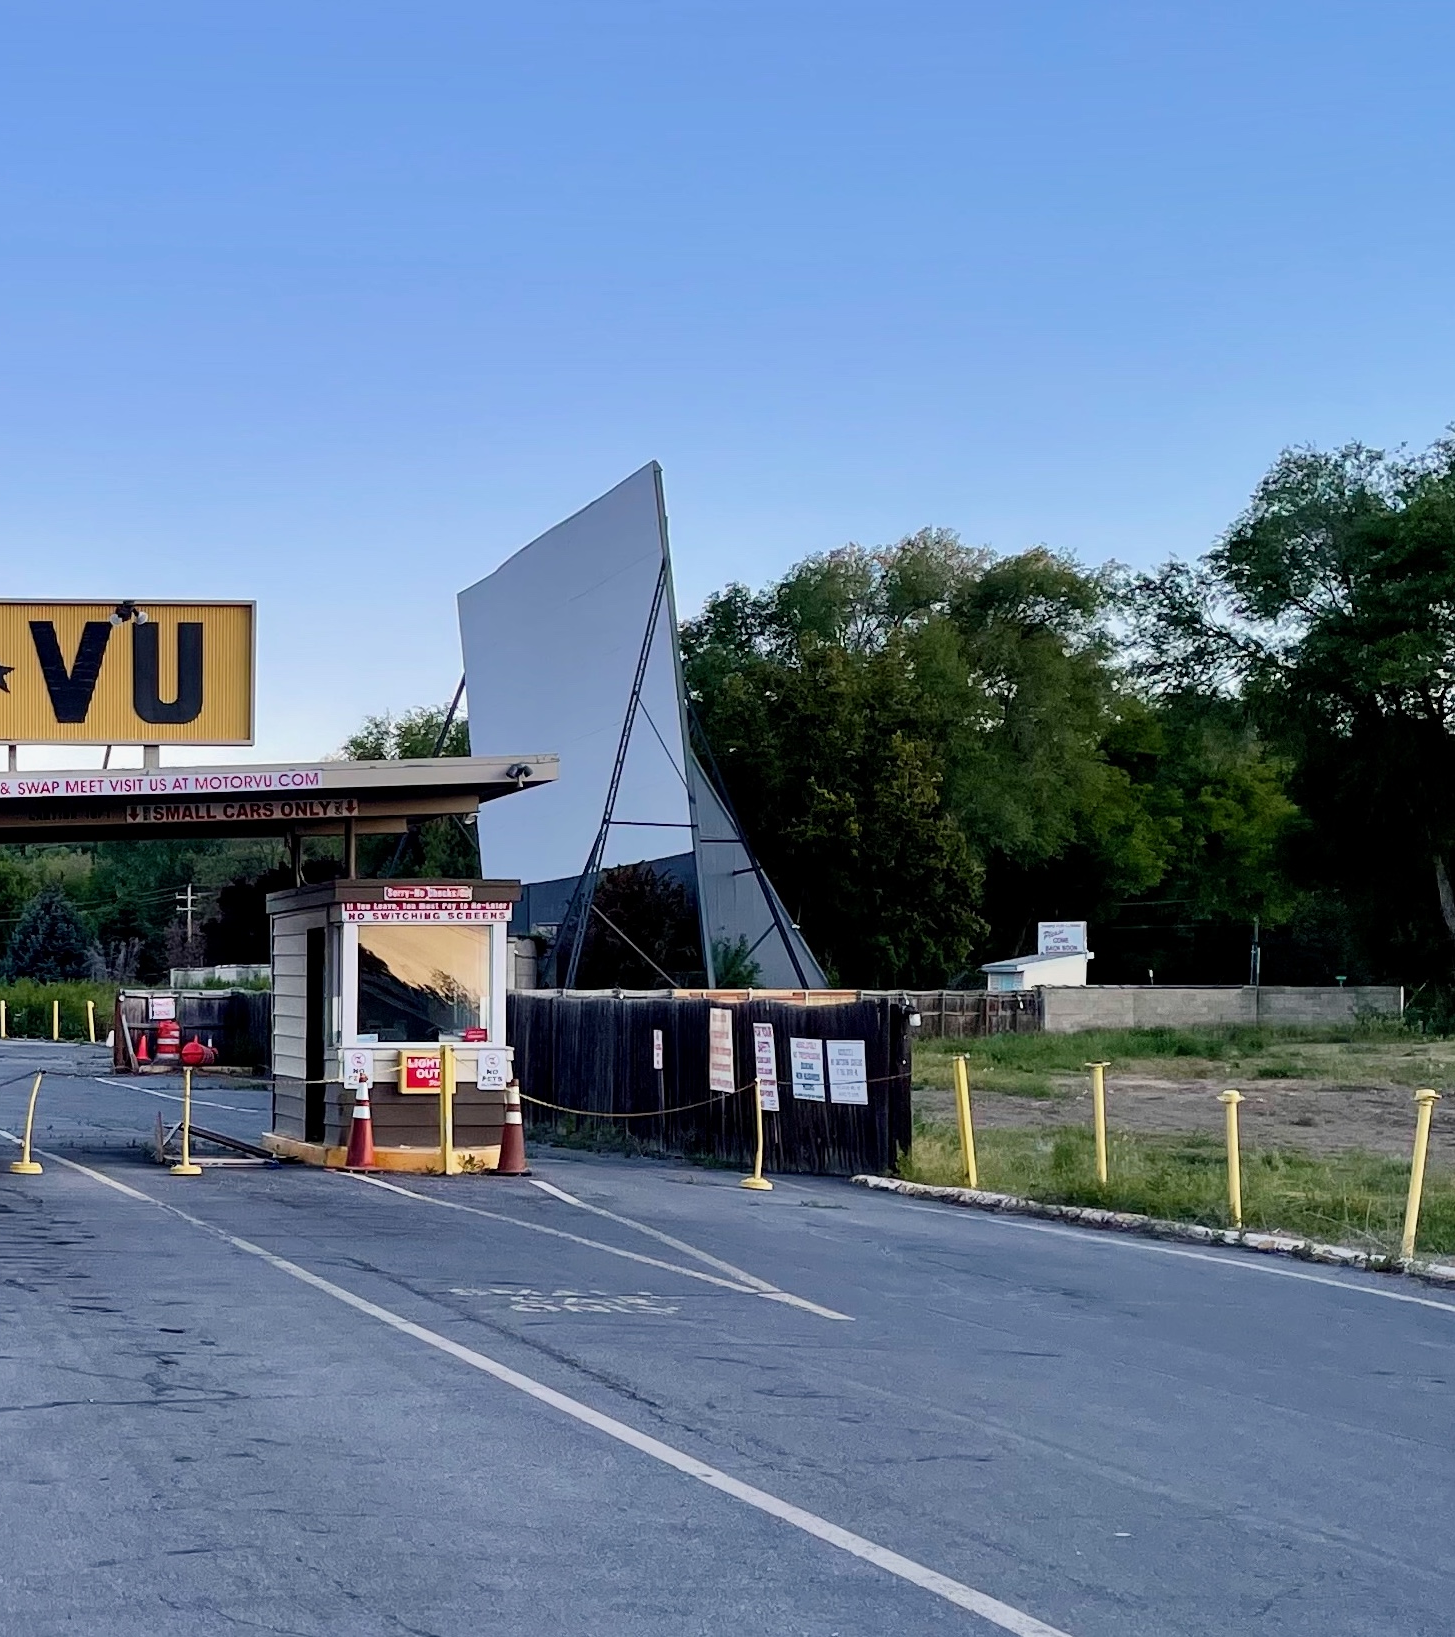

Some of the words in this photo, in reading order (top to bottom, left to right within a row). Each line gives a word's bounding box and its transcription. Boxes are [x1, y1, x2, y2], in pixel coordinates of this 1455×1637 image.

[28, 621, 204, 724] VU
[0, 782, 11, 795] &
[17, 780, 60, 795] SWAP
[66, 779, 104, 794] MEET
[110, 778, 144, 793] VISIT
[149, 777, 167, 792] US
[172, 777, 188, 791] AT
[195, 772, 319, 790] MOTORVU.COM
[152, 803, 217, 822] SMALL
[222, 802, 274, 819] CARS
[280, 800, 332, 817] ONLY
[348, 912, 365, 920] NO
[372, 912, 441, 920] SWITCHING
[407, 1058, 441, 1069] LIGHT
[415, 1069, 440, 1079] OUT
